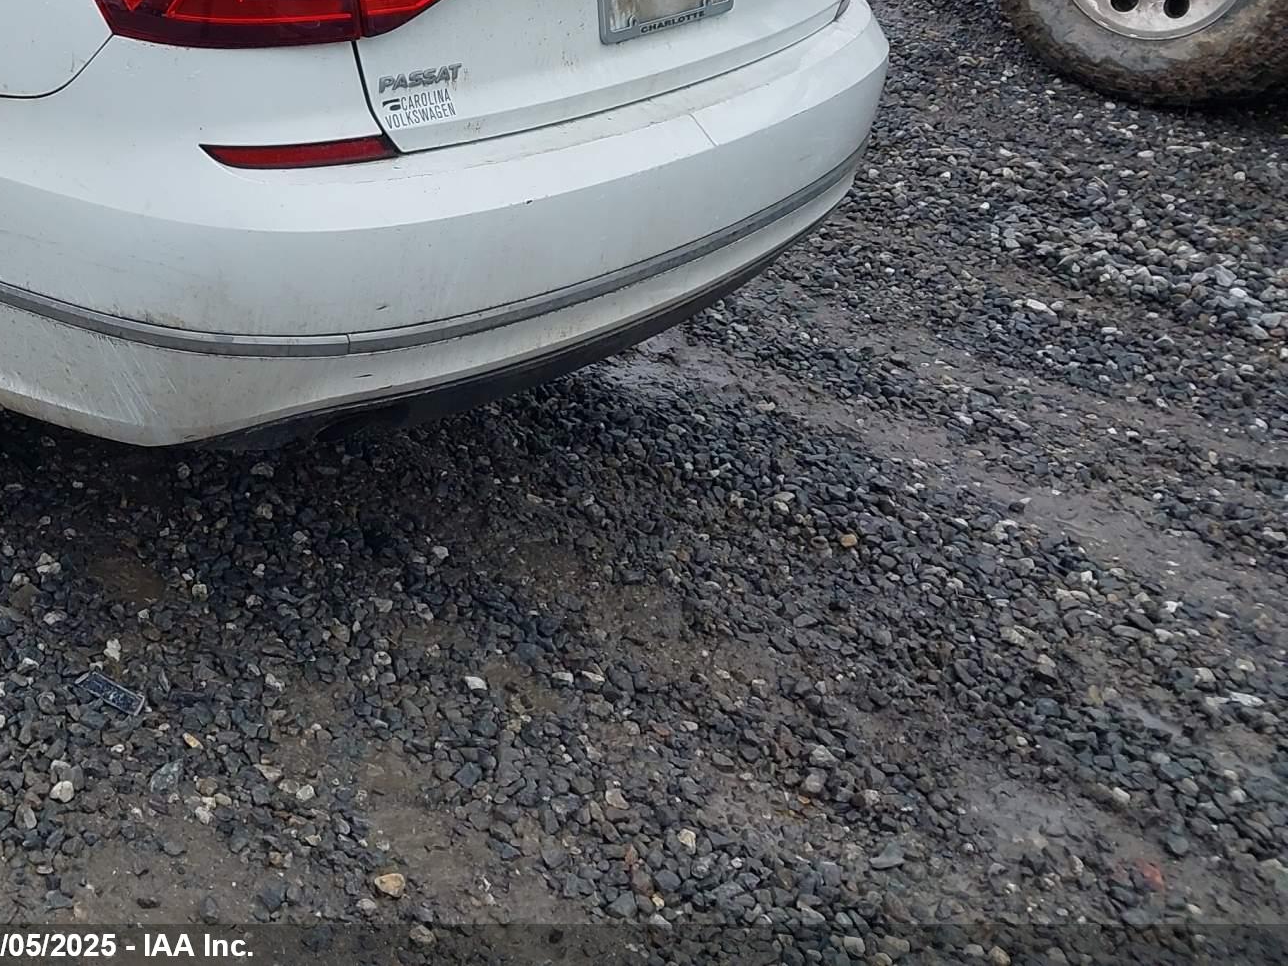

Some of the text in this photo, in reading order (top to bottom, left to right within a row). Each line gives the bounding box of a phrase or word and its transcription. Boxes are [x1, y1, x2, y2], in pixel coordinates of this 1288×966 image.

[640, 10, 705, 34] CHARLOTTE
[378, 62, 462, 94] PASSAT
[400, 88, 451, 111] CAROLINA
[385, 102, 457, 129] VOLKSWAGEN
